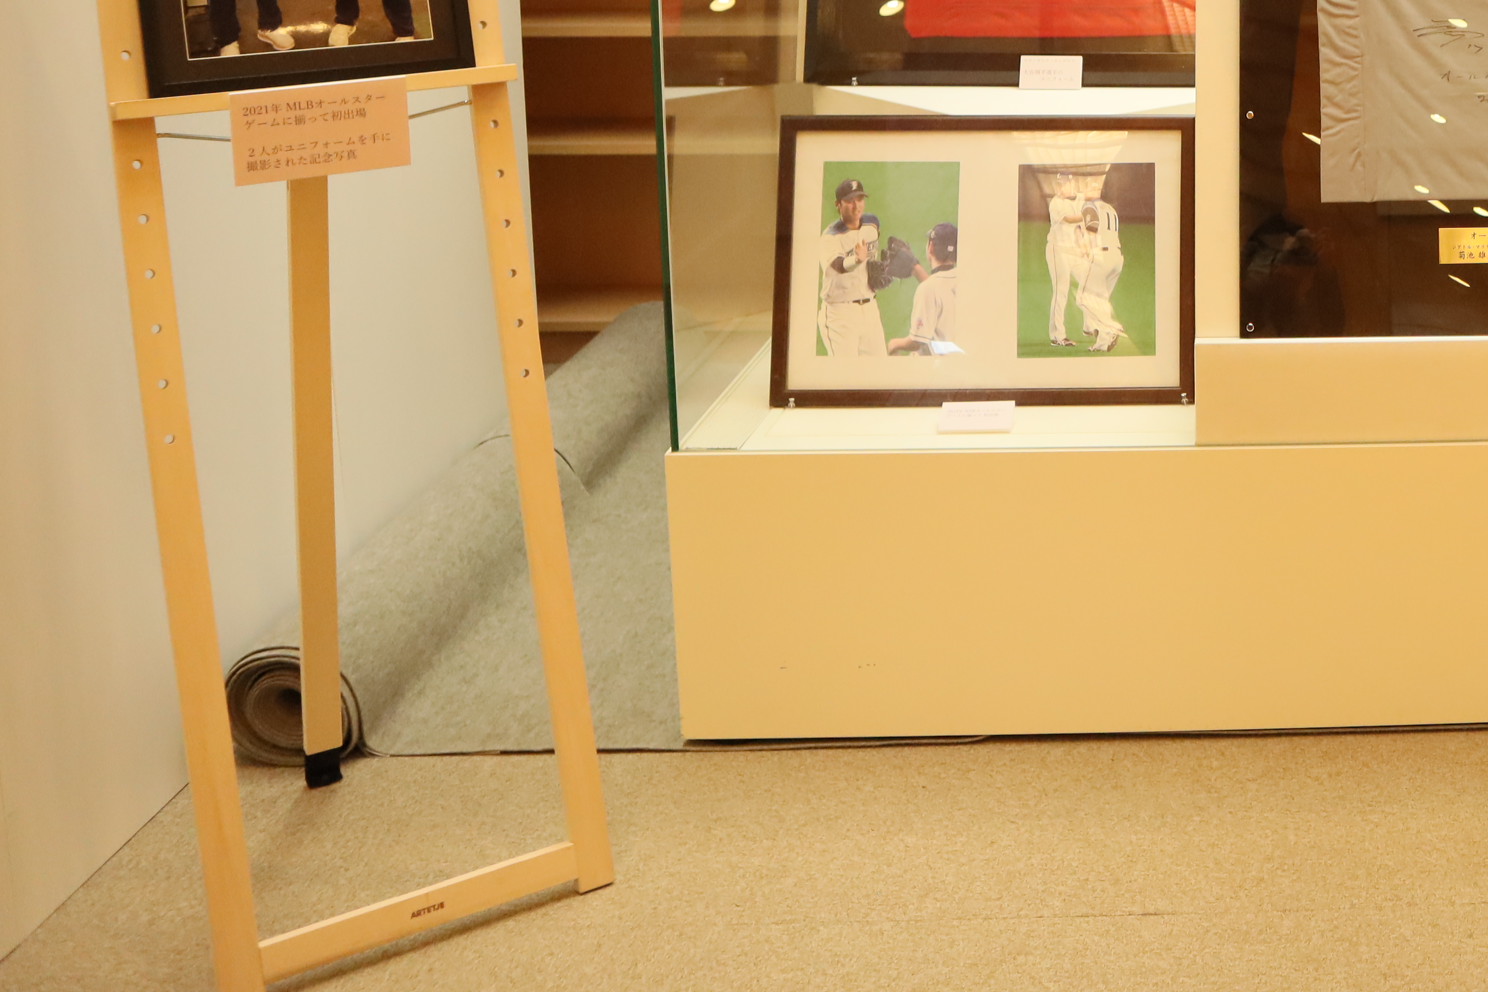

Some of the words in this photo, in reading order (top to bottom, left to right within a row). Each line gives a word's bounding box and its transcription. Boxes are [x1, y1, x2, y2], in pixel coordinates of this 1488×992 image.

[246, 149, 358, 173] 撮影された記念写真
